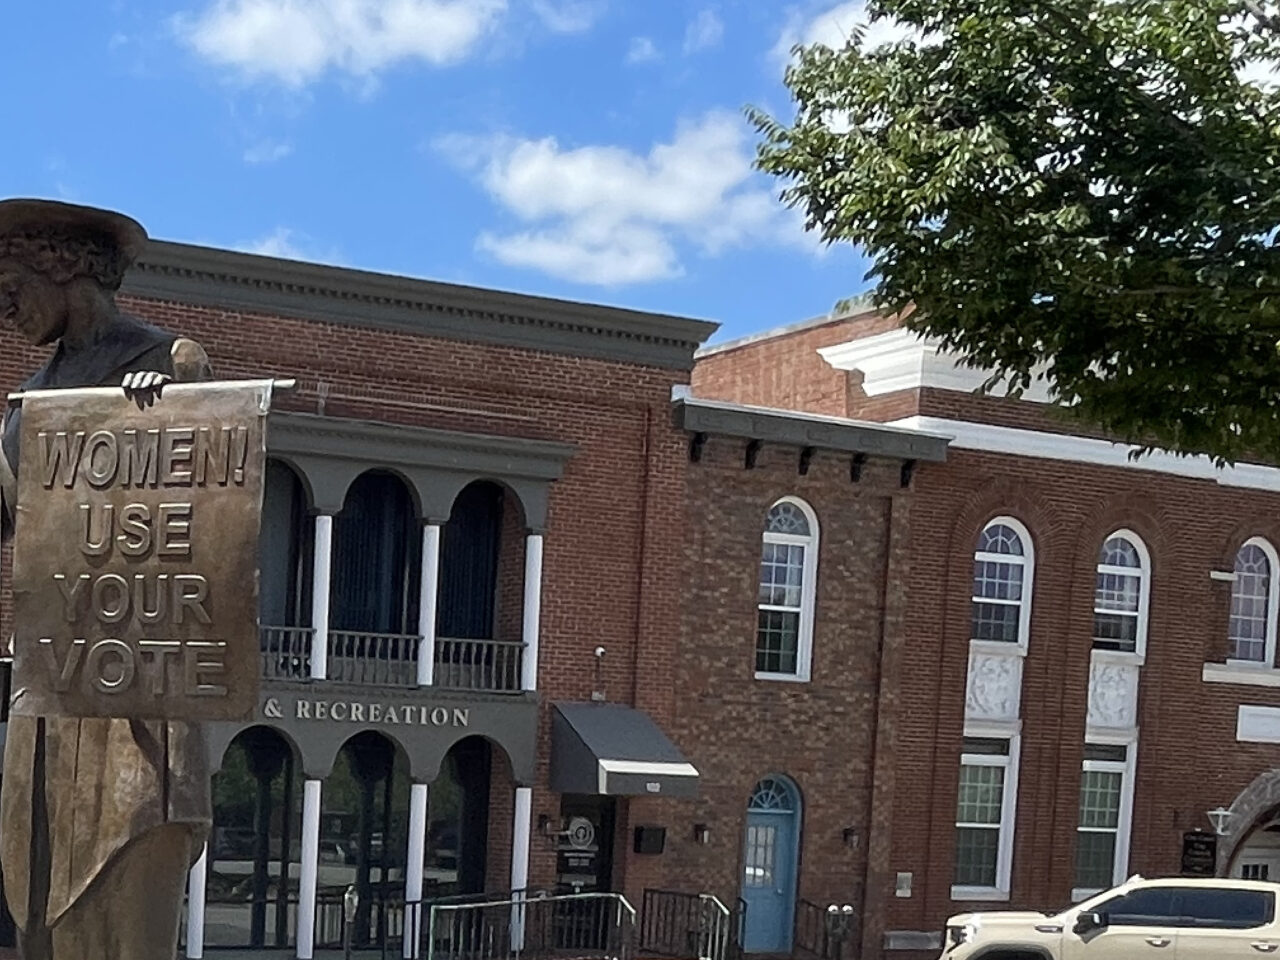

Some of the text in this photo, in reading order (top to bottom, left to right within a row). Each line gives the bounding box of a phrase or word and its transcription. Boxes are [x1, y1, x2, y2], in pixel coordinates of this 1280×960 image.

[37, 426, 249, 490] WOMEN!
[78, 502, 193, 562] USE
[52, 573, 214, 626] YOUR
[37, 637, 228, 697] VOTE
[263, 698, 470, 727] & RECREATION
